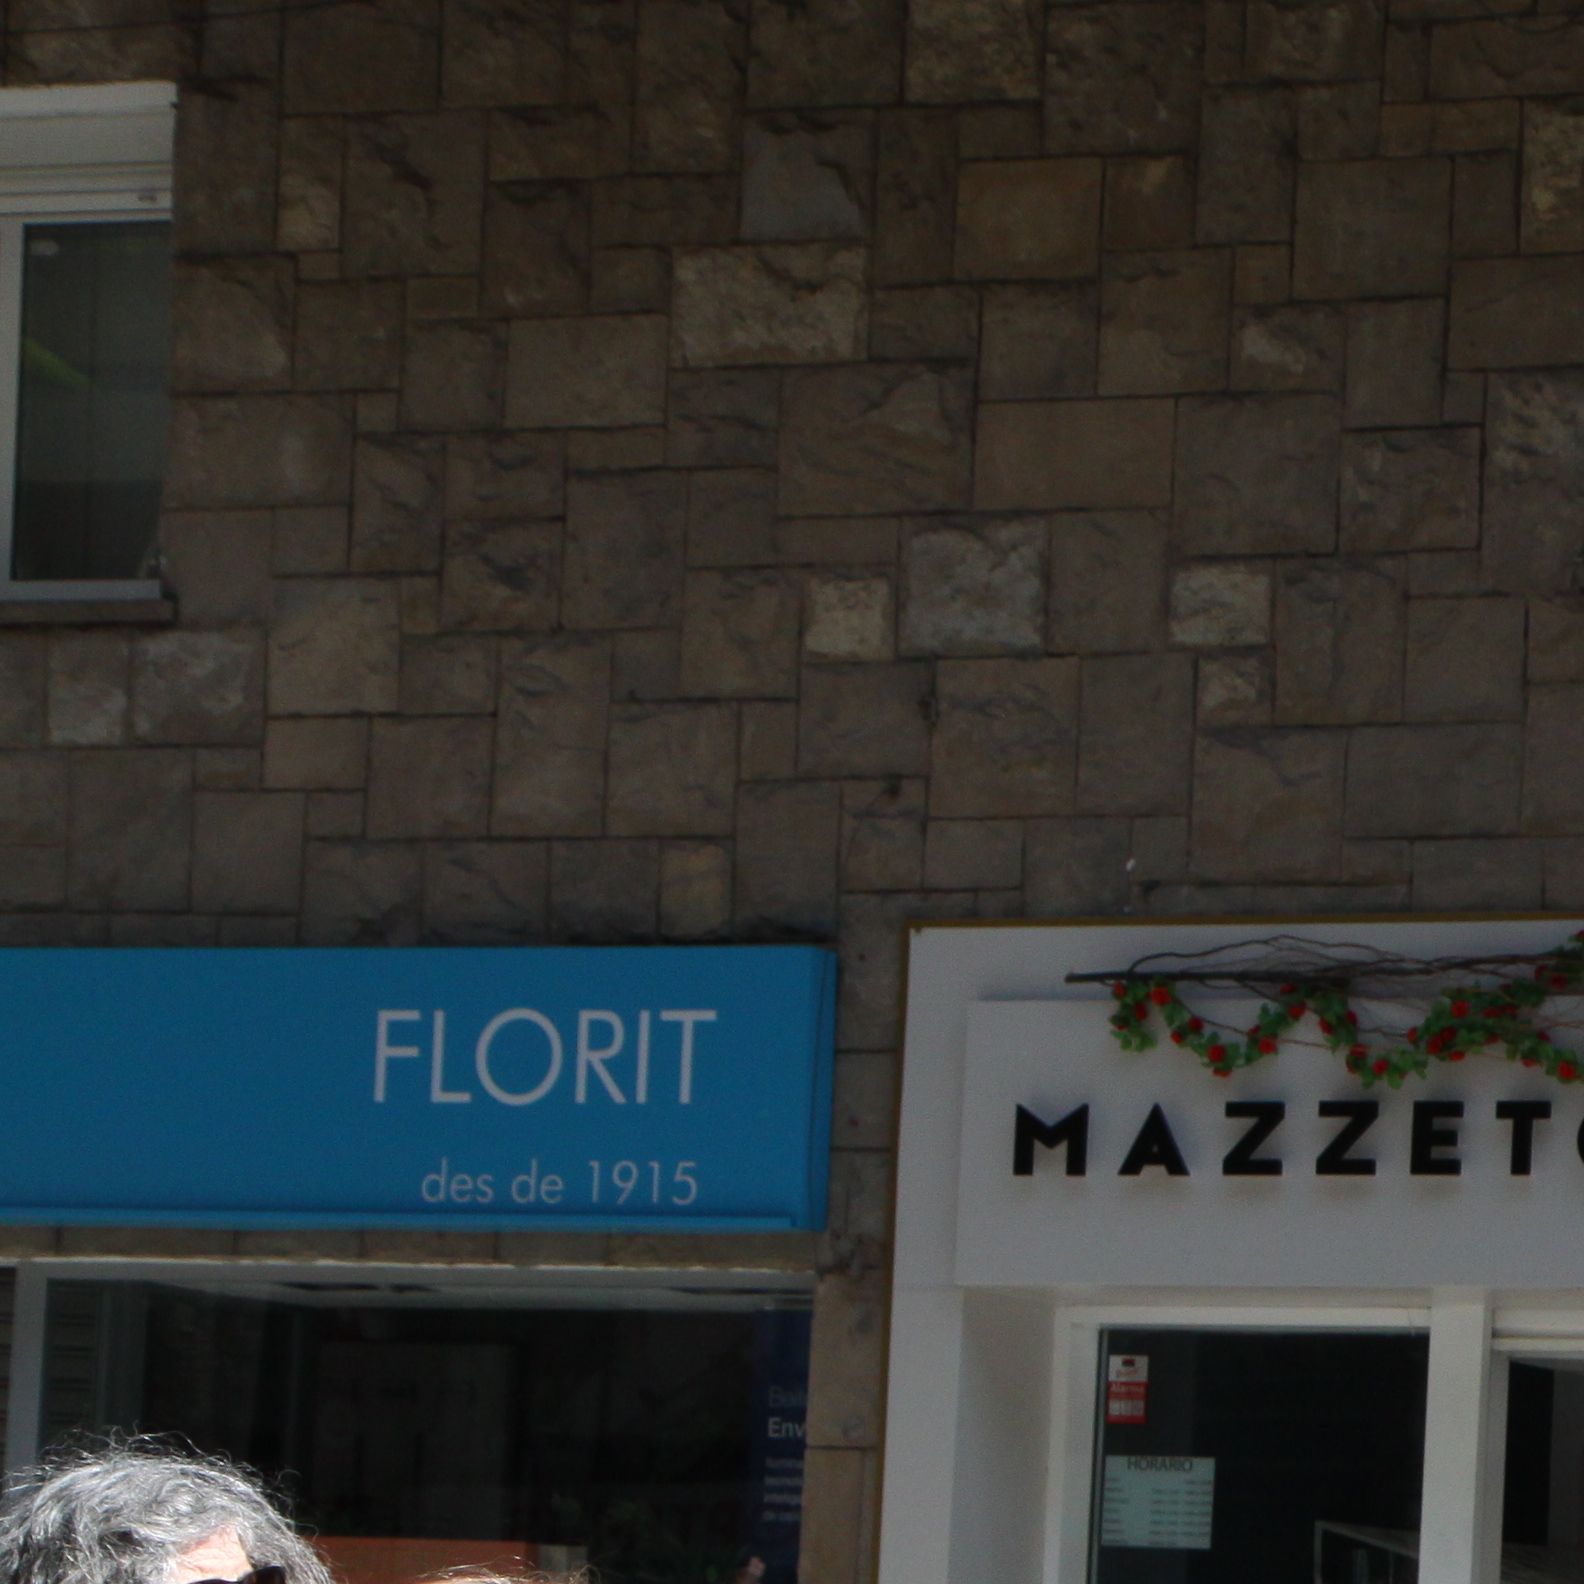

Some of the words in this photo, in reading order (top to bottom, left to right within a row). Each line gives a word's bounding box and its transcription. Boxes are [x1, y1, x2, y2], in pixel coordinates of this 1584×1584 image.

[373, 1007, 717, 1106] FLORIT
[421, 1158, 494, 1206] des
[511, 1159, 563, 1206] de
[587, 1159, 698, 1207] 1915
[1126, 1457, 1193, 1472] HORARIO
